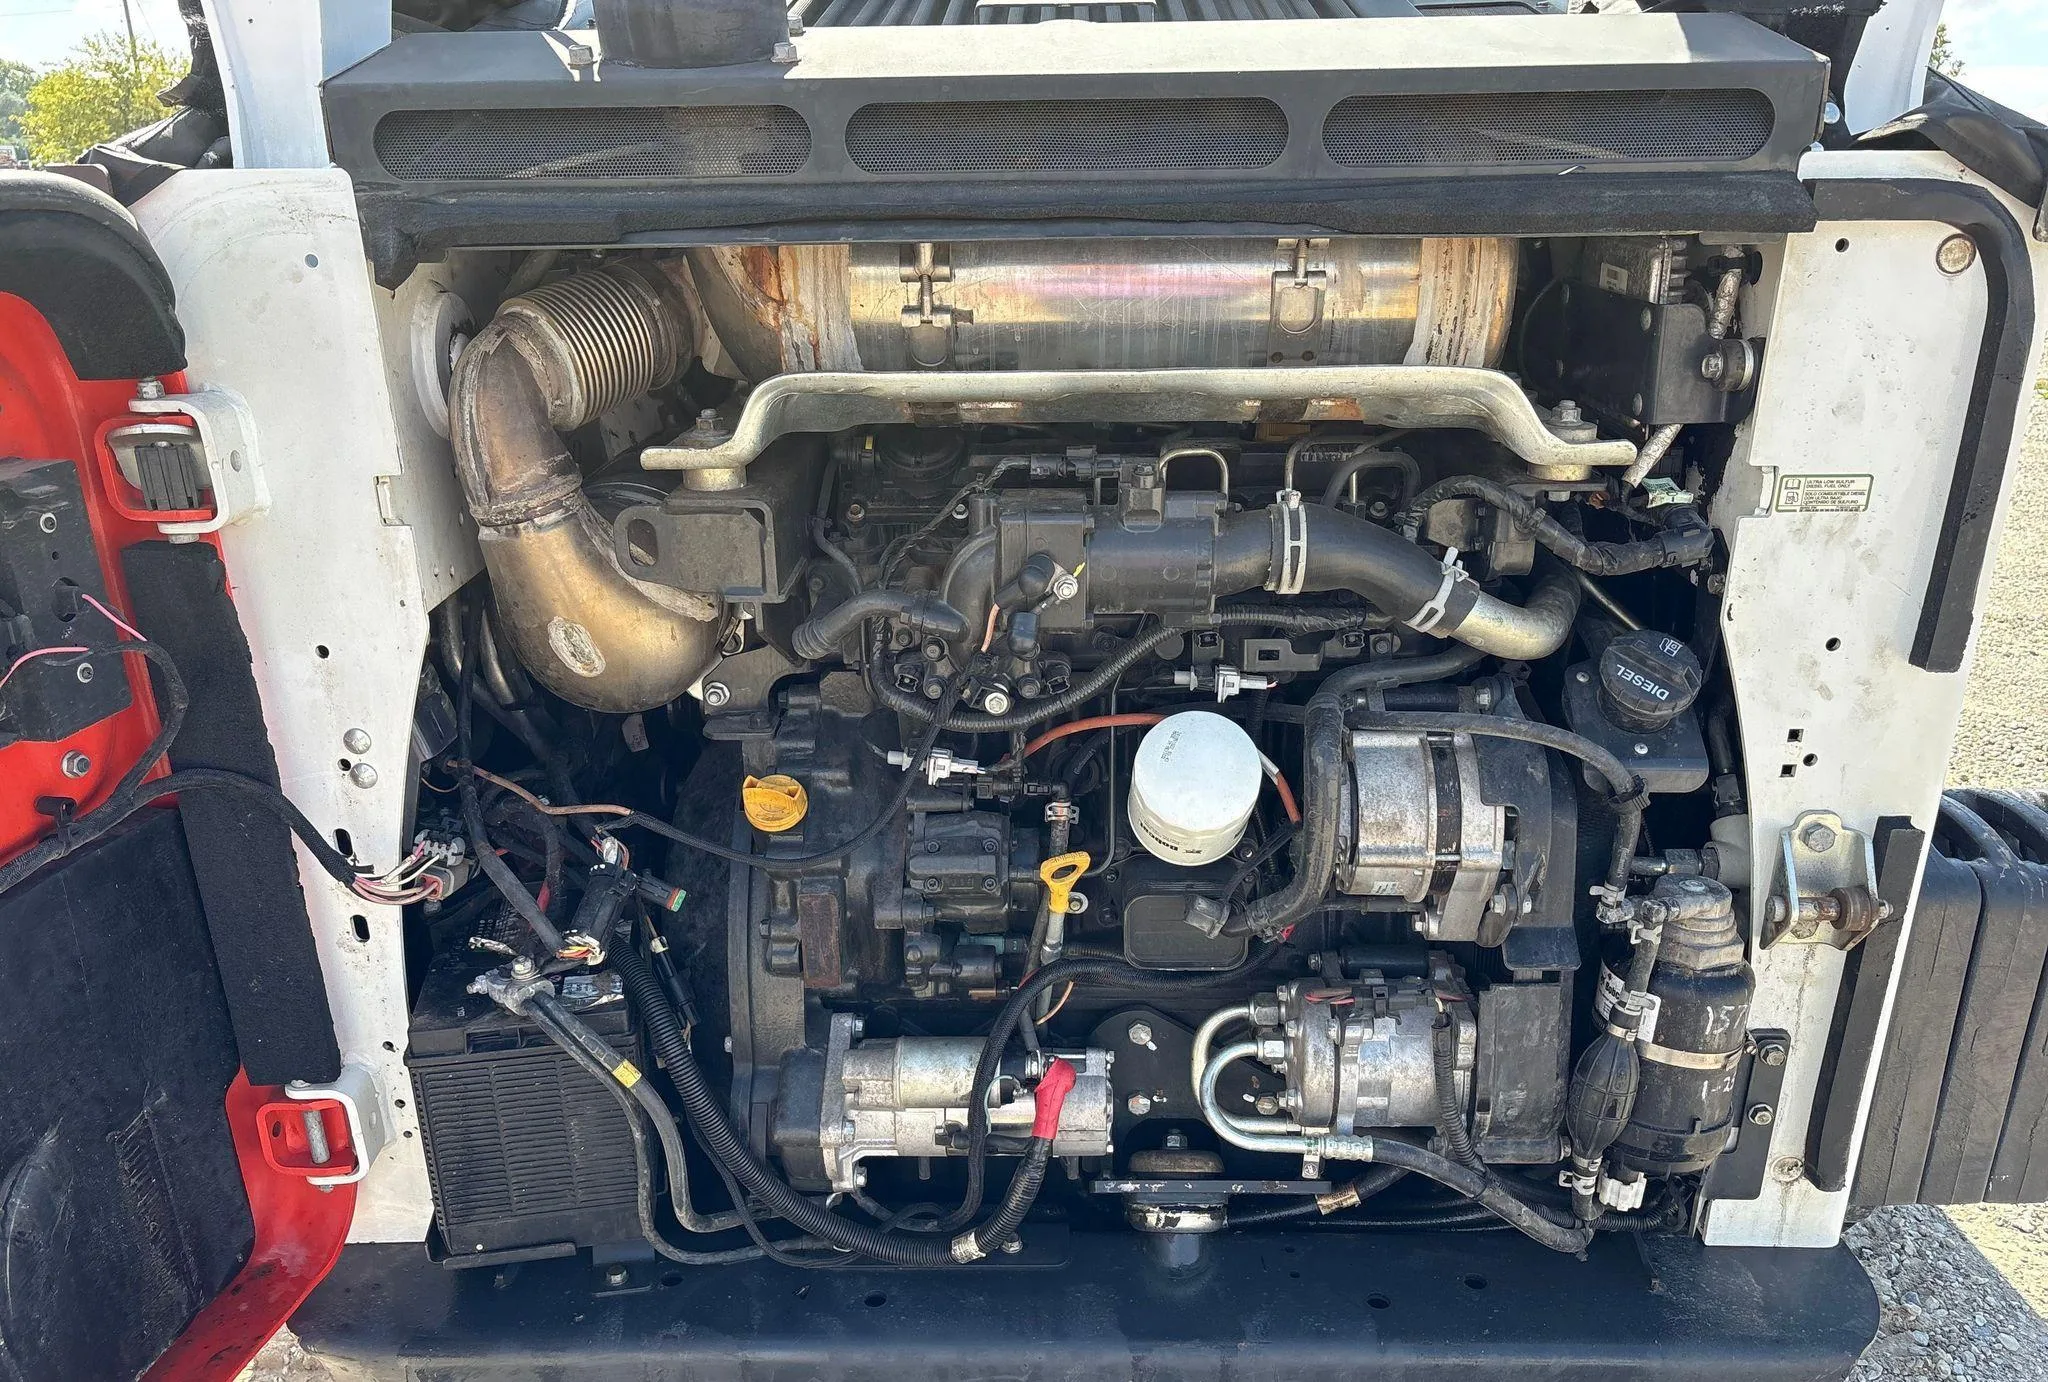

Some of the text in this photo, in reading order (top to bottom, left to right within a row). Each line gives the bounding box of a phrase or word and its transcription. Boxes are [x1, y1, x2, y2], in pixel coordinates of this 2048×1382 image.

[1616, 664, 1670, 701] DIESEL
[1605, 981, 1620, 1000] Bobc
[1704, 1004, 1748, 1035] 157
